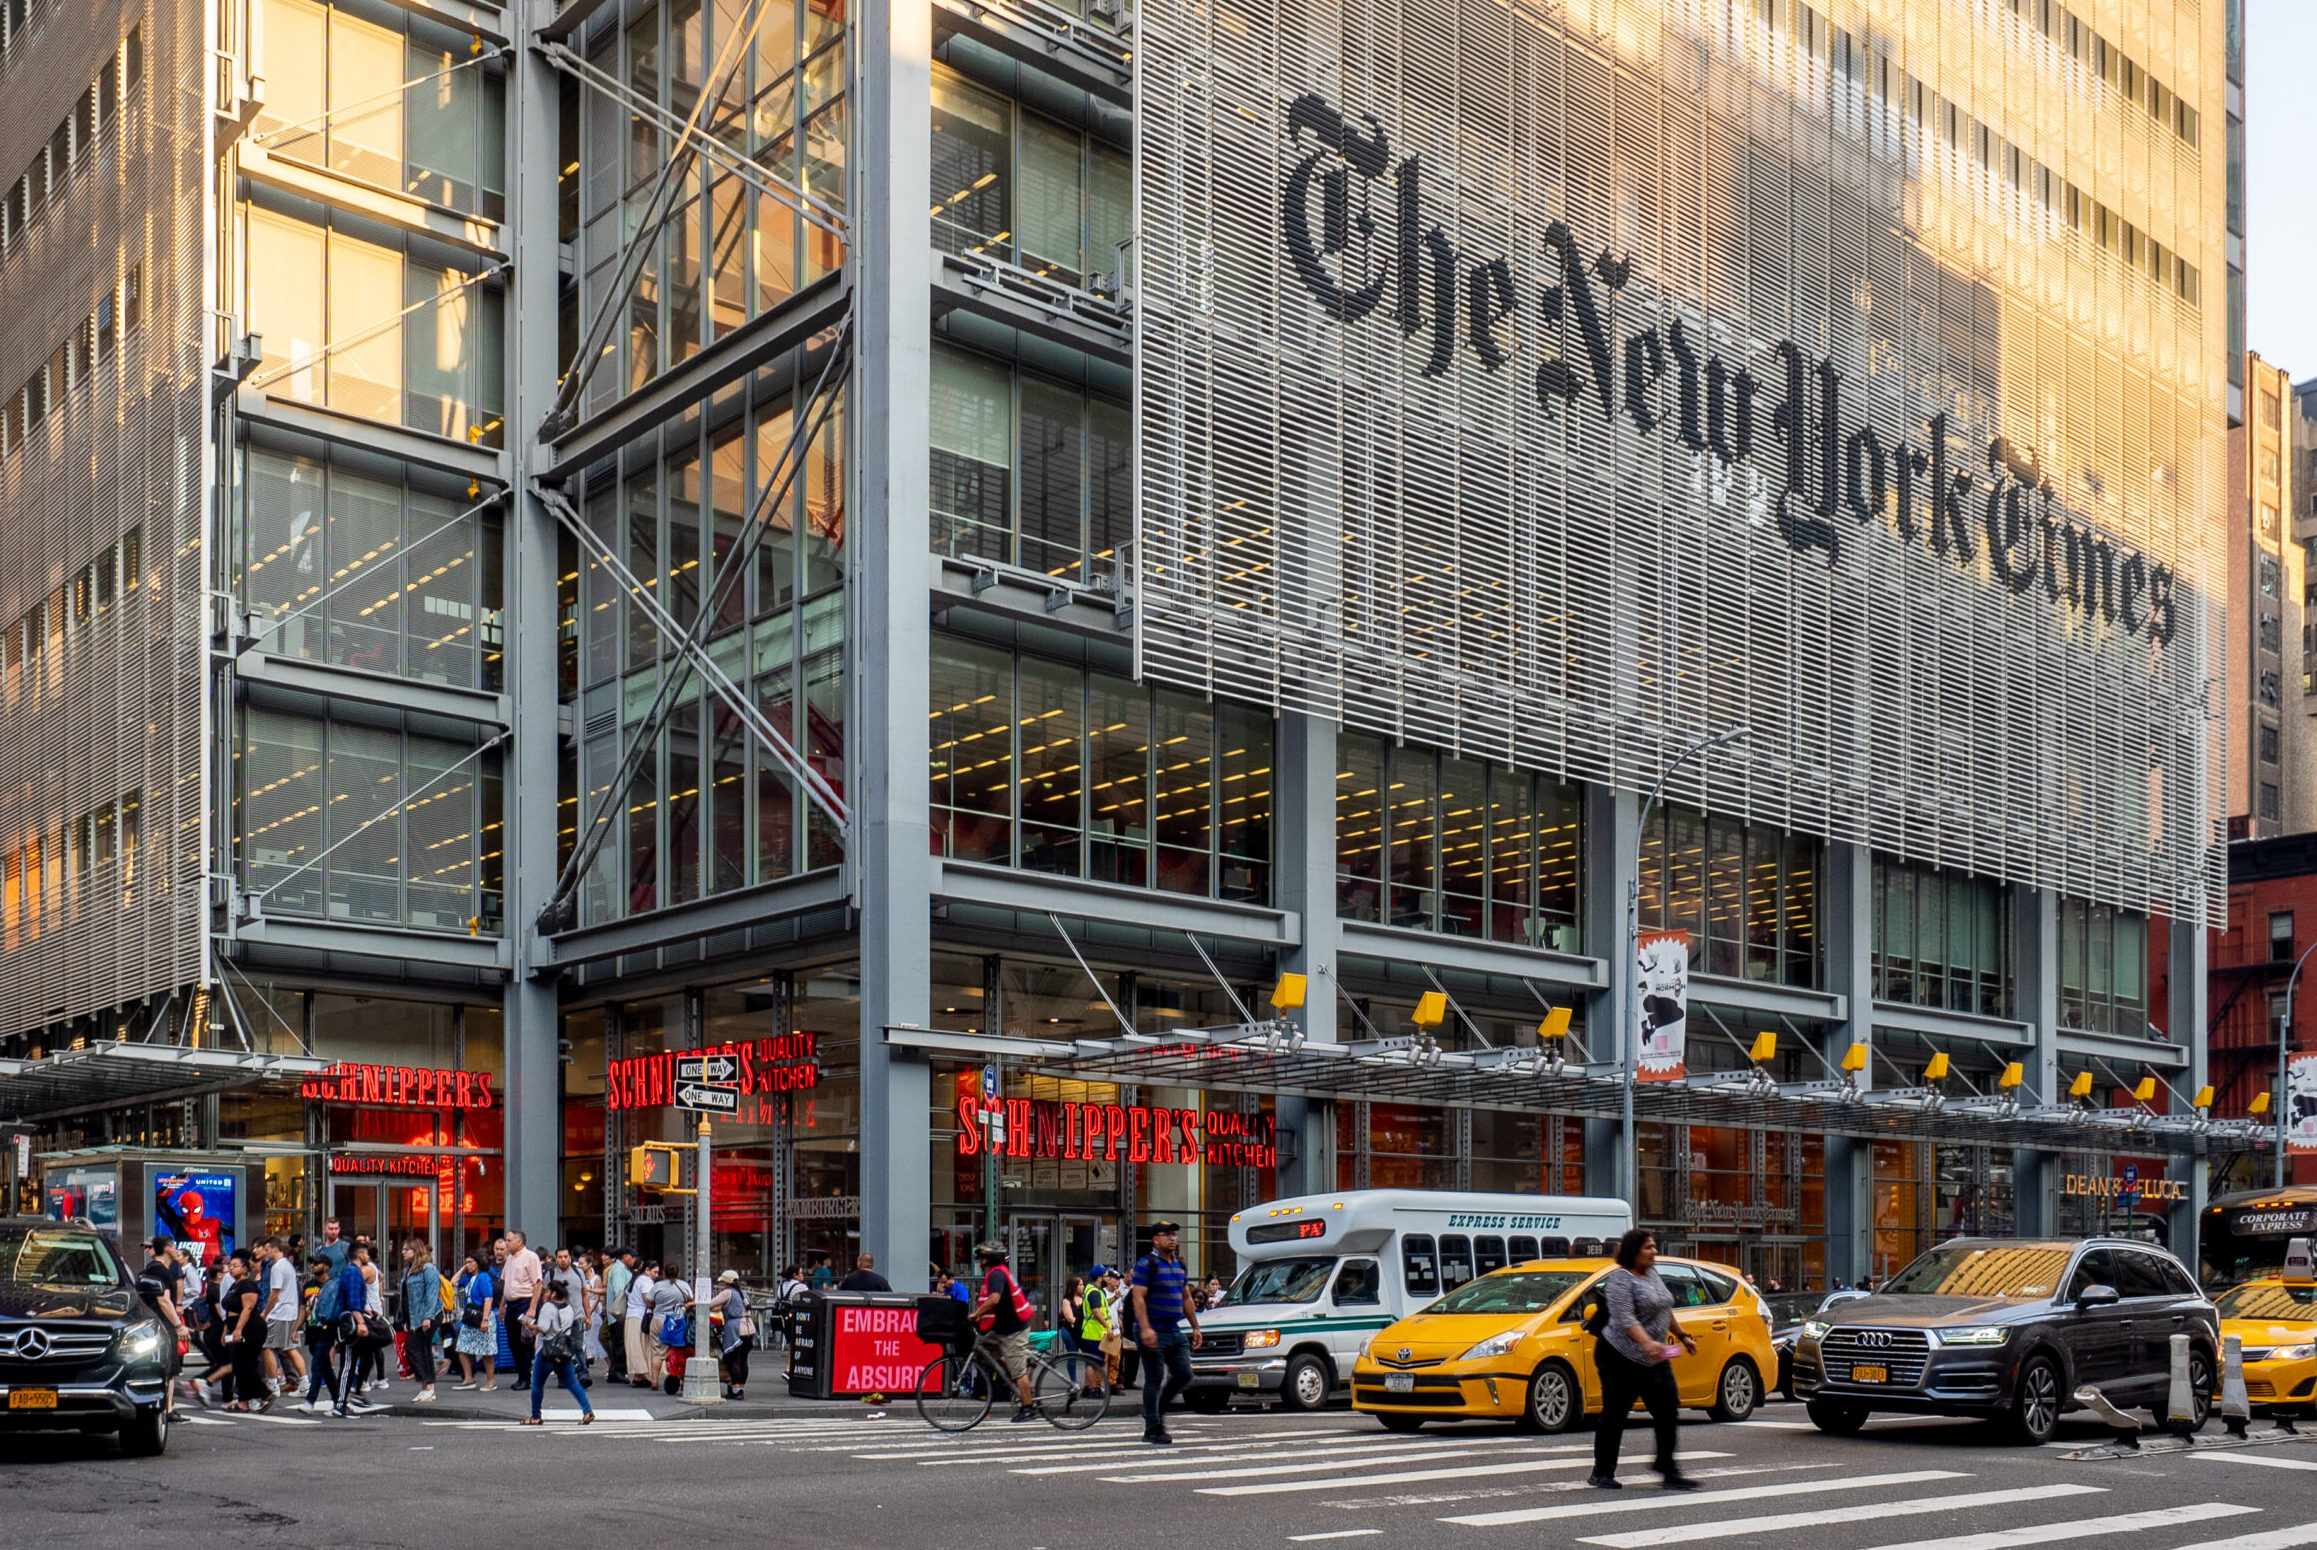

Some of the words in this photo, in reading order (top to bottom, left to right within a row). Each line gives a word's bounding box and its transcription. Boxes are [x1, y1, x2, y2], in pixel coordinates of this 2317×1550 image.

[1284, 92, 1517, 378] The
[1536, 219, 1762, 467] New
[1773, 339, 1974, 569] York
[1986, 434, 2175, 648] Times
[759, 1034, 816, 1063] QUALITY
[608, 1041, 755, 1110] SCHNI'S
[685, 1065, 703, 1076] ONE
[709, 1063, 729, 1075] WAY
[759, 1064, 816, 1093] KITCHEN
[684, 1090, 703, 1102] ONE
[711, 1093, 731, 1105] WAY
[1206, 1142, 1276, 1168] KITCHEN
[333, 1156, 385, 1174] QUALITY
[388, 1157, 439, 1175] KITCHEN
[195, 1178, 223, 1186] UNITED
[2066, 1174, 2109, 1197] DEAN
[2111, 1178, 2122, 1198] &
[2126, 1178, 2181, 1200] ELUCA
[1448, 1214, 1508, 1229] EXPRESS
[1509, 1216, 1562, 1230] SERVICE
[2239, 1211, 2310, 1225] CORPORATE
[2250, 1220, 2304, 1233] EXPRESS
[795, 1311, 811, 1322] DON'T
[795, 1325, 803, 1334] BE
[794, 1337, 814, 1349] AFRAID
[874, 1340, 900, 1356] THE
[794, 1351, 802, 1360] OF
[793, 1365, 814, 1376] ANYONE
[846, 1365, 926, 1390] ABSURD
